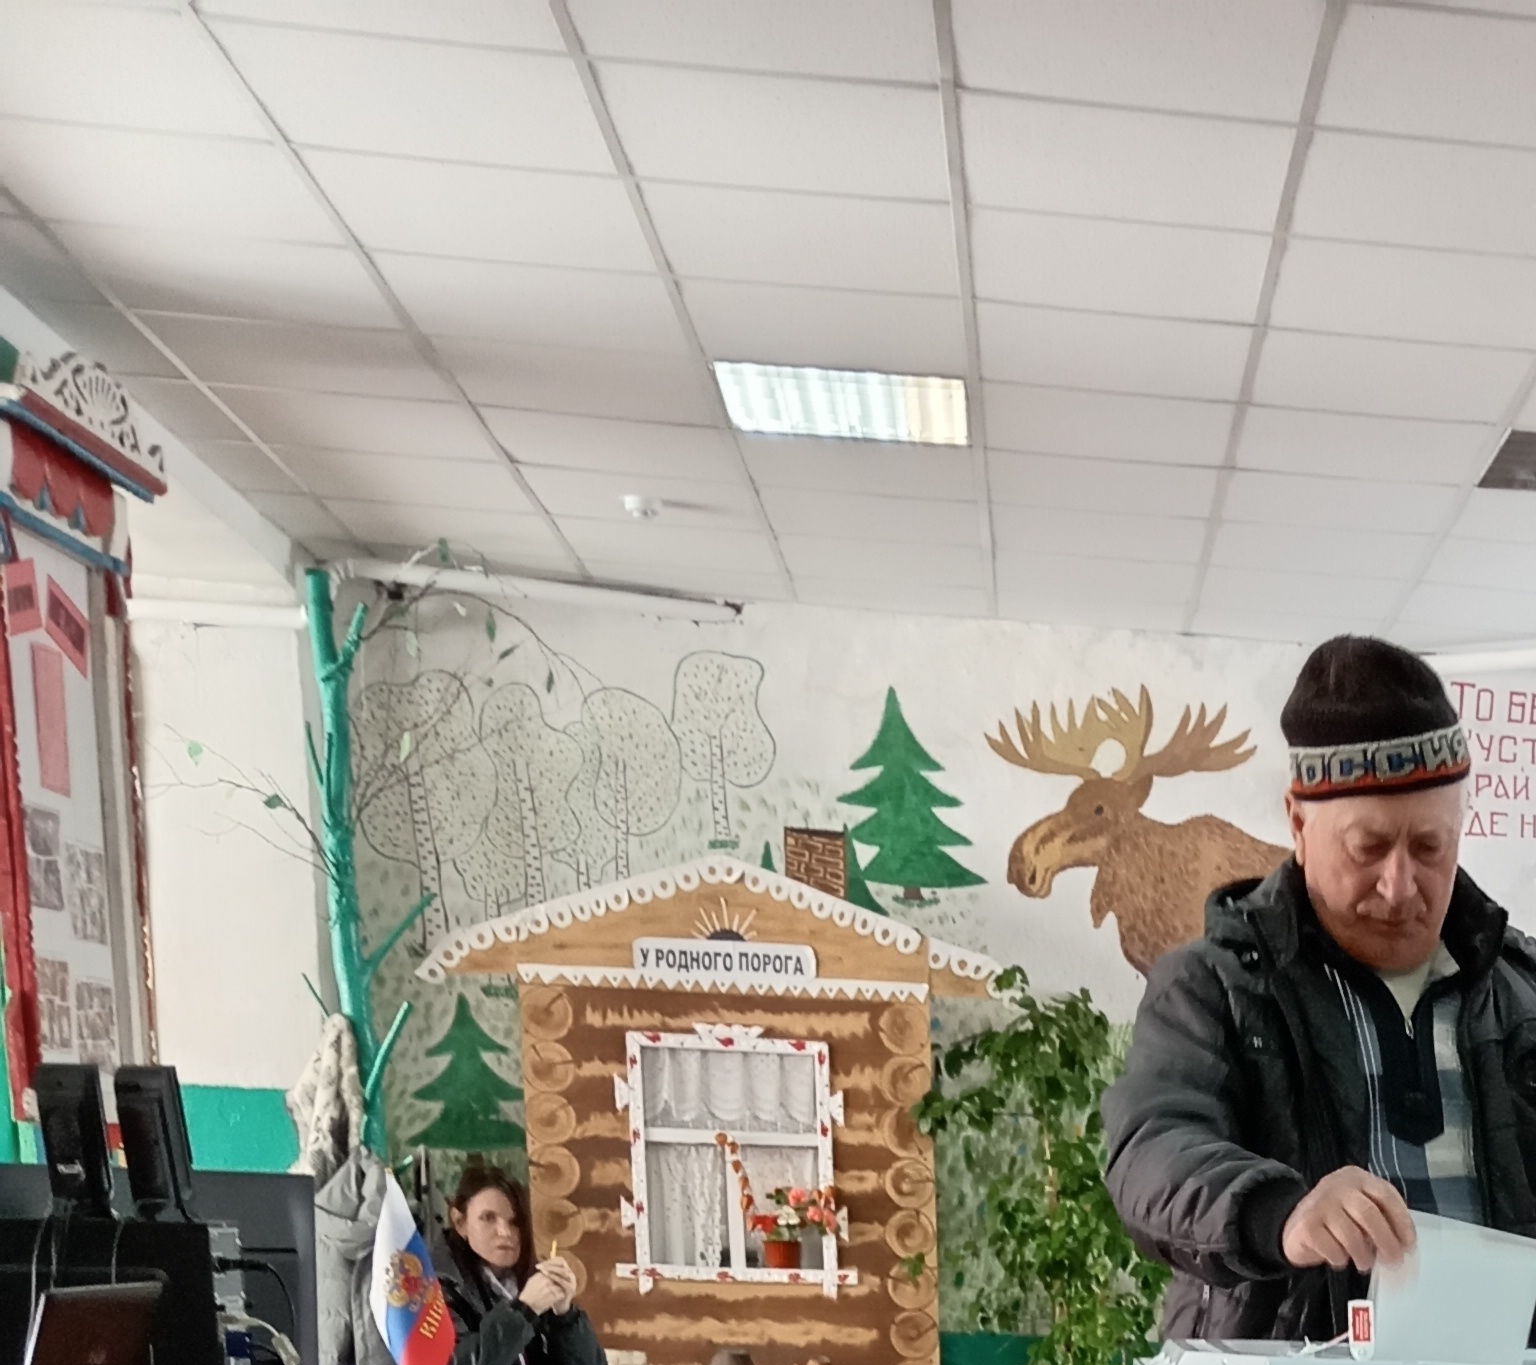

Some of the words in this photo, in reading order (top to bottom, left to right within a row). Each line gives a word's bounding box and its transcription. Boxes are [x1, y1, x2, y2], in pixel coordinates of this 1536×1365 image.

[1451, 681, 1494, 721] ТО
[1467, 766, 1530, 801] РАЙ
[1465, 804, 1508, 838] ДЕ
[640, 947, 650, 967] У
[655, 948, 733, 973] РОДНОГО
[738, 952, 804, 976] ПОРОГА
